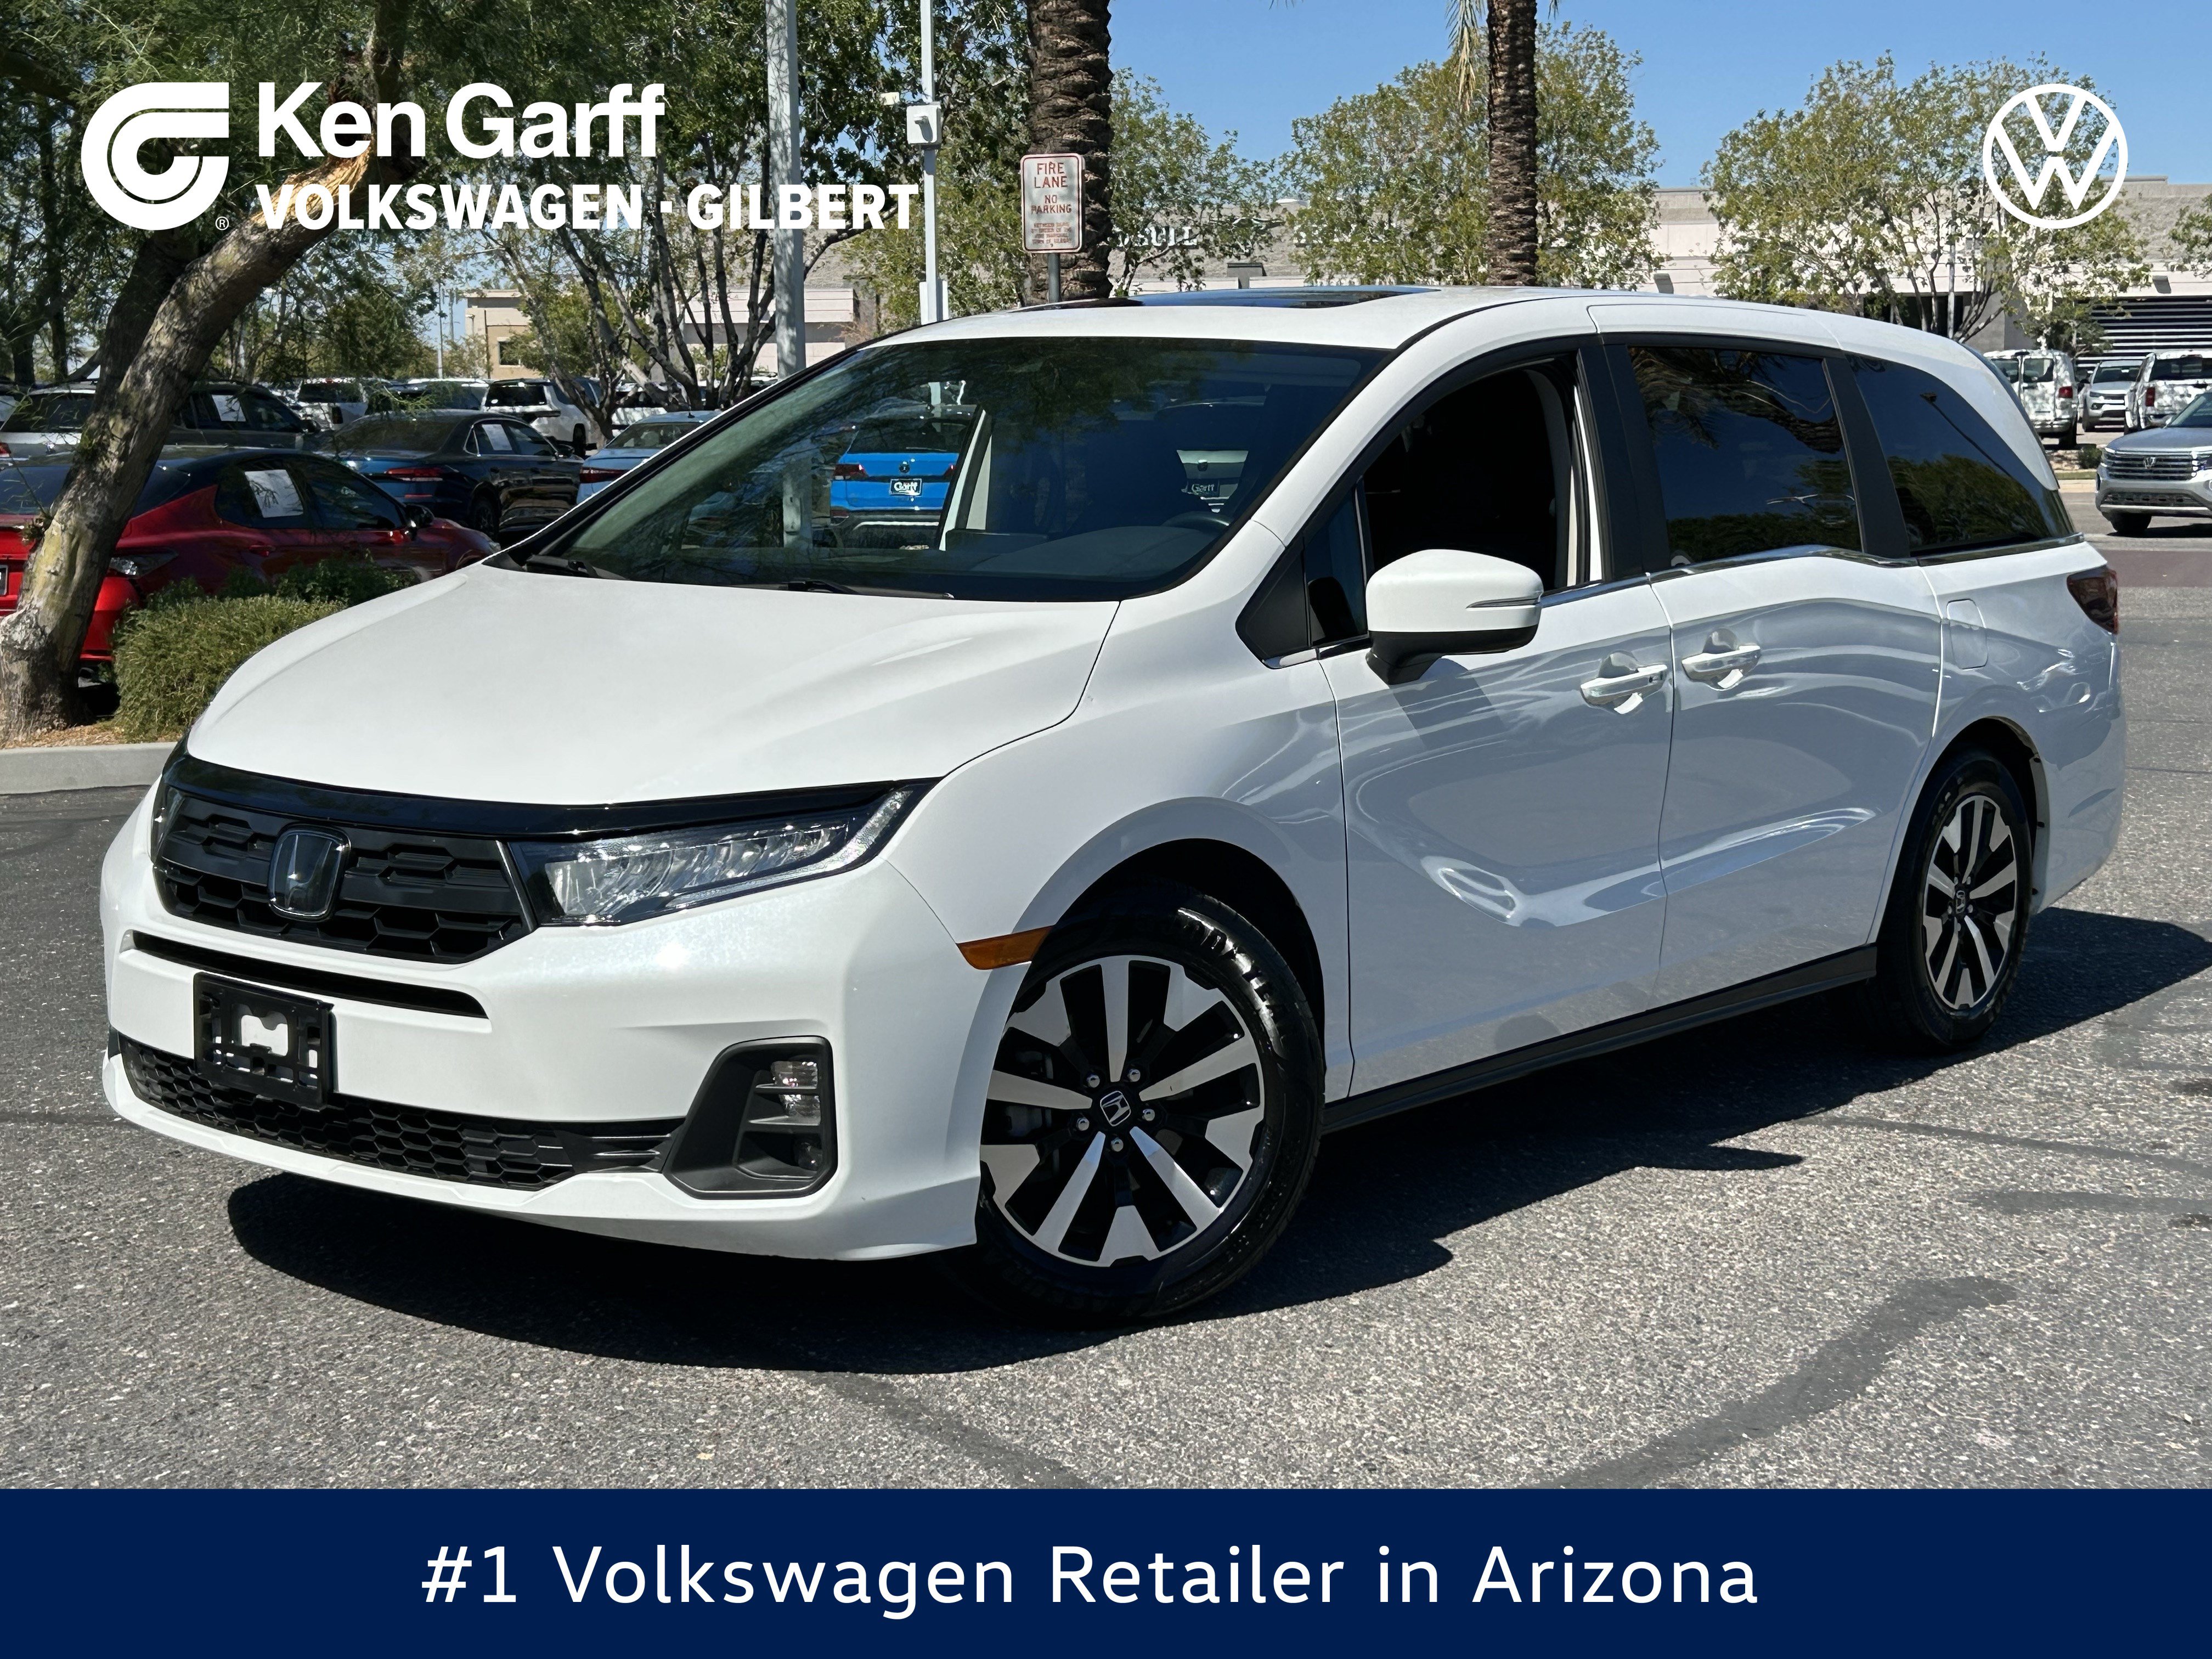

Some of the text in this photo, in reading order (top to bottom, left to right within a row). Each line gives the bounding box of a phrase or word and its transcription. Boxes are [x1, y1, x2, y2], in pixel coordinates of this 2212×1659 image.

[1037, 161, 1065, 174] FIRE
[1034, 176, 1068, 188] LANE
[1045, 194, 1057, 204] NO
[1031, 204, 1072, 214] PARKING
